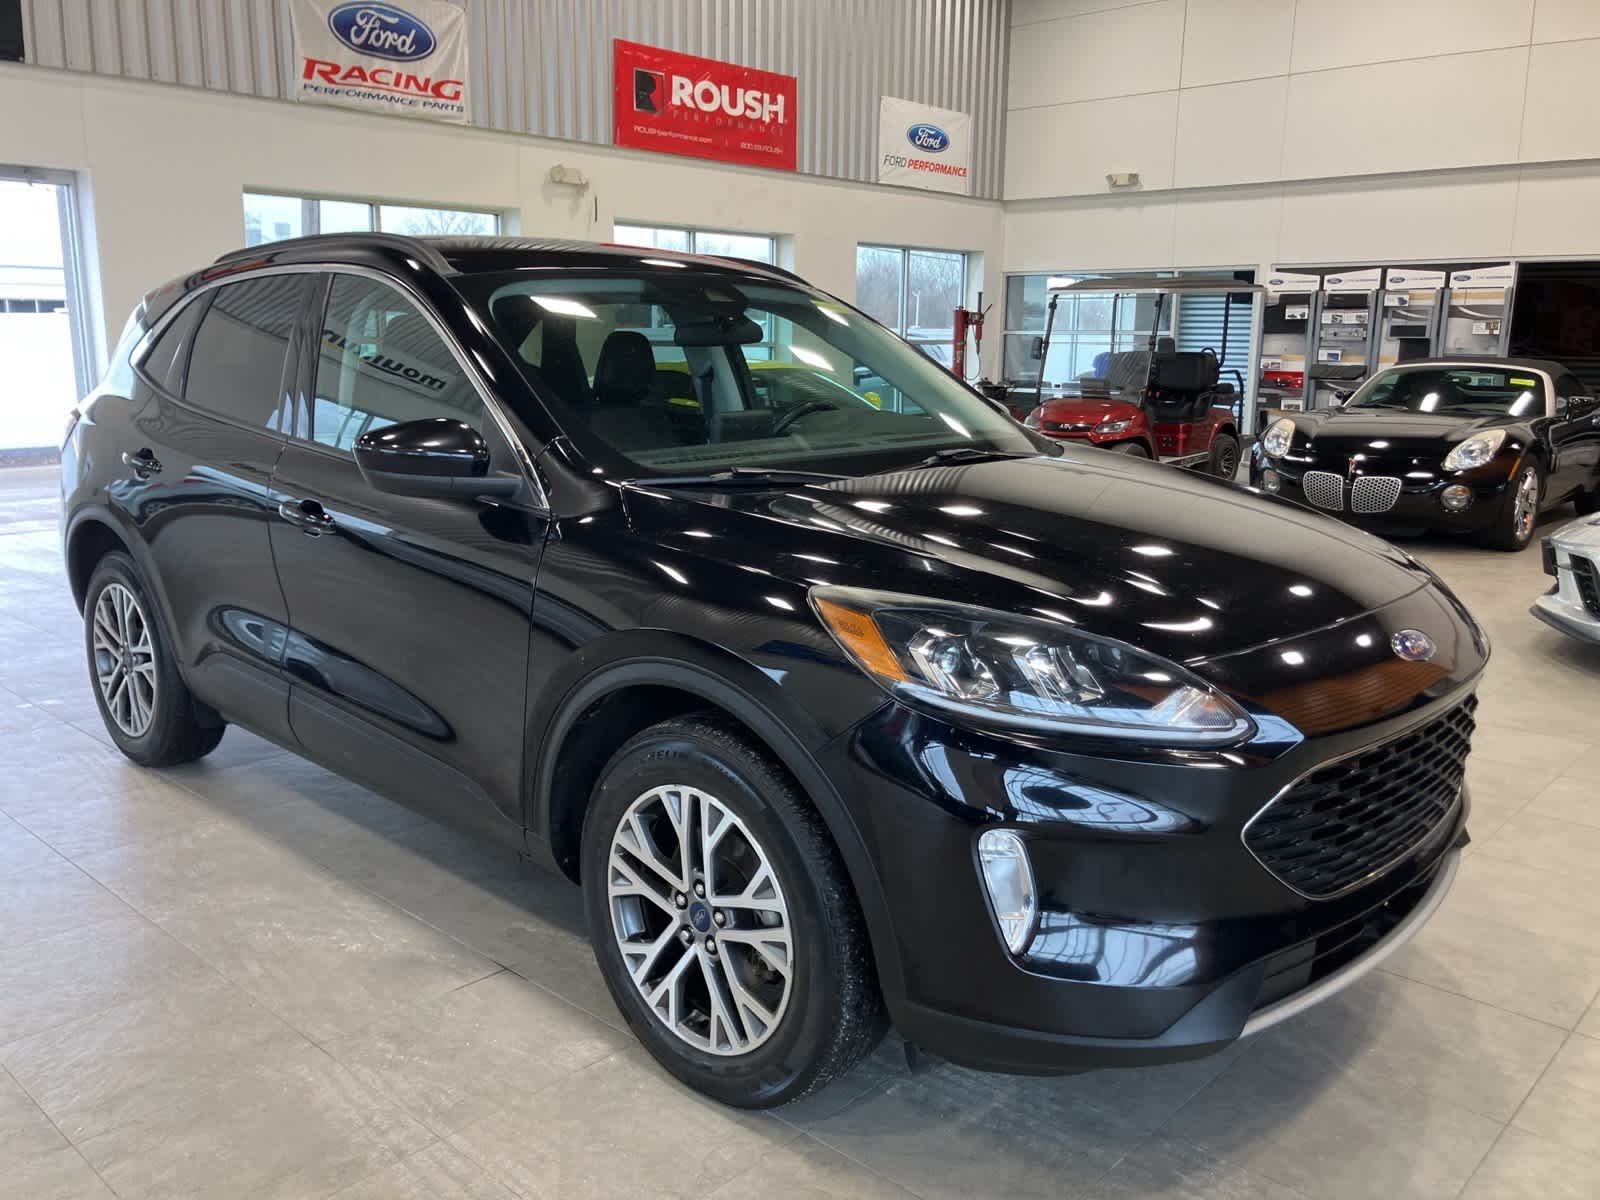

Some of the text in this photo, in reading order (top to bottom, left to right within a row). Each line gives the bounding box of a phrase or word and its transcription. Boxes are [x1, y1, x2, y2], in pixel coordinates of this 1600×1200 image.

[350, 9, 416, 54] Ford
[303, 58, 464, 101] RACING
[303, 83, 464, 112] PERFORMANCE PARTS
[671, 75, 785, 124] ROUSH
[915, 127, 942, 148] Ford
[883, 154, 967, 177] FORD PERFORMANCE
